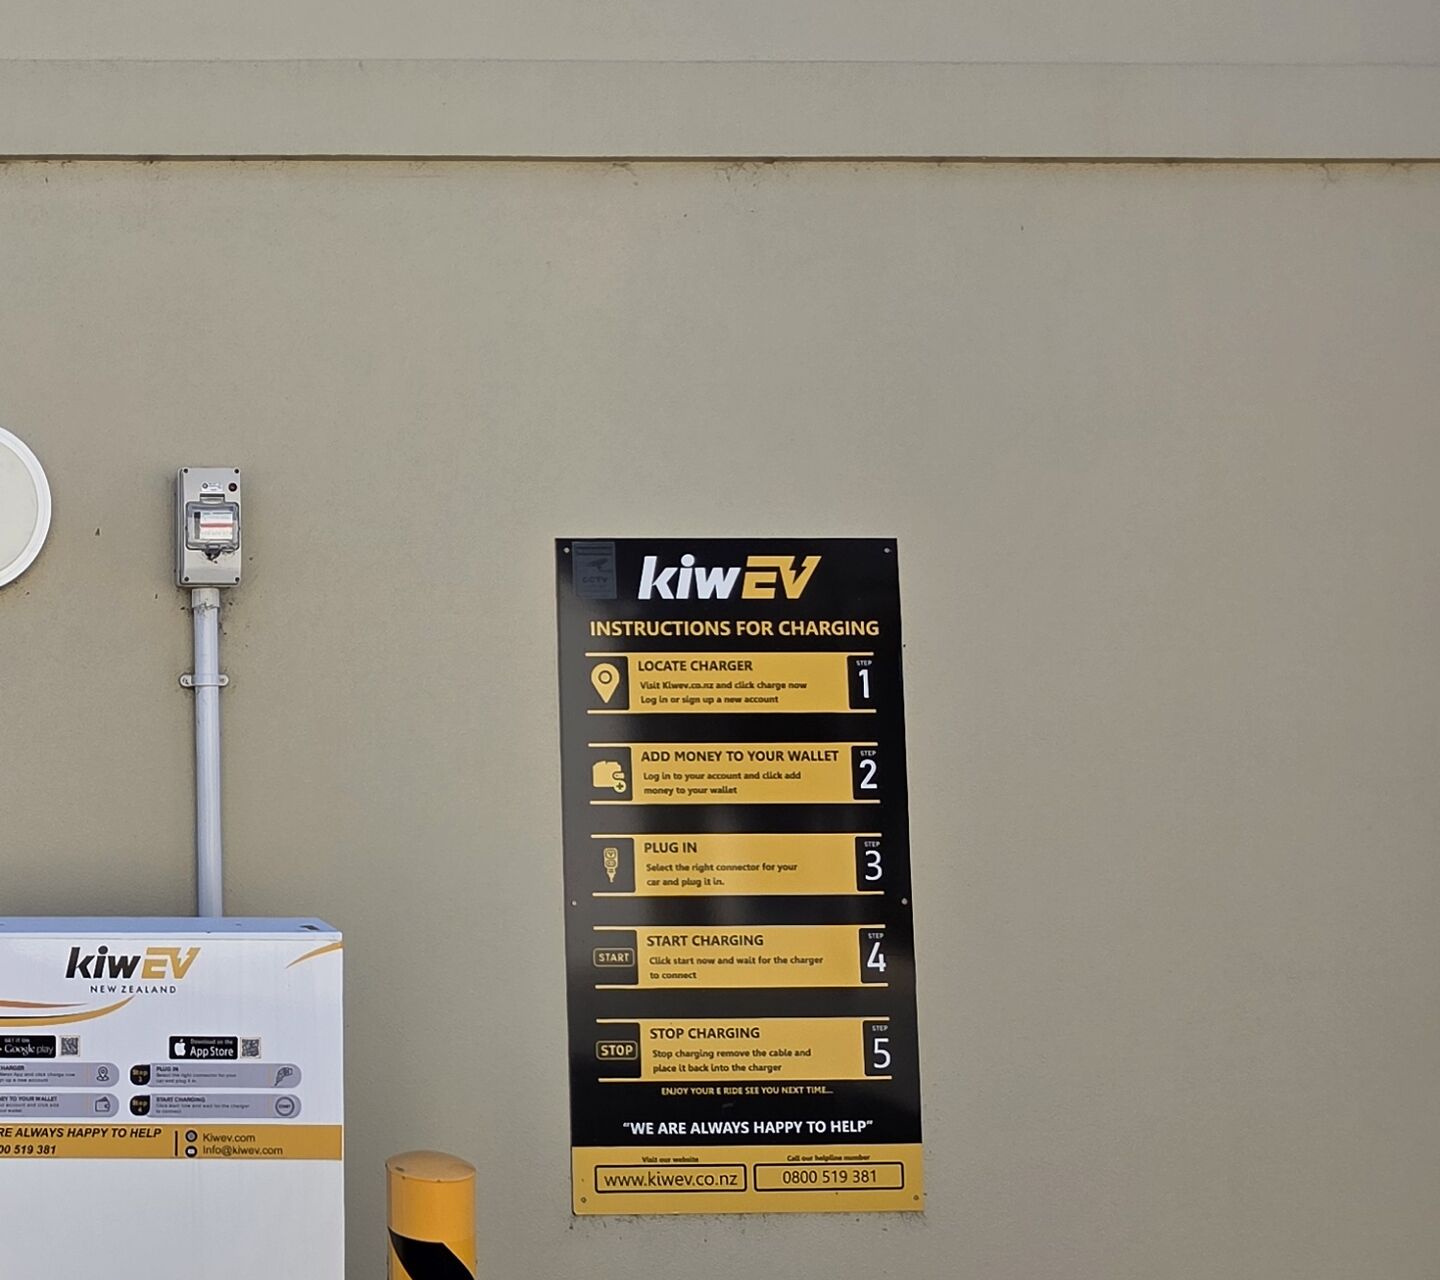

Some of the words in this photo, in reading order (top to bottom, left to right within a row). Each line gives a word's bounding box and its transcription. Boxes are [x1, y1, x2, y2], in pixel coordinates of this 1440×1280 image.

[638, 554, 822, 599] kiwEV
[590, 620, 731, 637] INSTRUCTIONS
[736, 620, 774, 636] FOR
[778, 620, 880, 636] CHARGING
[638, 660, 686, 671] LOCATE
[690, 660, 753, 671] CHARGER
[640, 681, 660, 689] Visit
[662, 681, 714, 689] Kiwev.co.nz
[716, 681, 732, 689] and
[734, 681, 754, 689] click
[756, 681, 786, 691] charge
[858, 669, 870, 699] 1
[640, 696, 657, 705] Log
[682, 695, 700, 705] sign
[702, 697, 714, 705] up
[641, 751, 670, 762] ADD
[674, 751, 722, 762] MONEY
[726, 751, 744, 762] TO
[747, 751, 784, 761] YOUR
[787, 750, 839, 761] WALLET
[643, 772, 659, 782] Log
[661, 772, 670, 780] in
[859, 758, 878, 789] 2
[643, 787, 673, 796] money
[687, 787, 708, 796] your
[709, 786, 737, 794] wallet
[644, 842, 678, 853] PLUG
[682, 842, 697, 853] IN
[692, 863, 714, 873] right
[777, 864, 797, 872] your
[865, 850, 883, 881] 3
[681, 878, 702, 887] plug
[646, 935, 688, 946] START
[692, 935, 764, 946] CHARGING
[65, 945, 201, 979] kiwEV
[598, 953, 629, 962] START
[649, 957, 671, 965] Click
[673, 957, 694, 965] start
[736, 956, 756, 964] wait
[758, 956, 771, 964] for
[773, 956, 788, 964] the
[790, 956, 823, 966] charger
[867, 941, 887, 972] 4
[90, 985, 117, 993] NEW
[121, 985, 177, 993] ZEALAND
[649, 1028, 684, 1039] STOP
[688, 1028, 760, 1039] CHARGING
[4, 1043, 35, 1056] Google
[36, 1044, 54, 1055] play
[190, 1046, 209, 1058] App
[210, 1046, 234, 1057] Store
[600, 1045, 633, 1056] STOP
[652, 1050, 673, 1059] Stop
[675, 1050, 714, 1059] charging
[873, 1038, 891, 1069] 5
[652, 1064, 677, 1073] place
[678, 1064, 686, 1072] it
[688, 1064, 708, 1072] back
[710, 1064, 729, 1072] into
[748, 1063, 782, 1073] charger
[661, 1087, 688, 1095] ENJOY
[690, 1087, 714, 1095] YOUR
[723, 1087, 743, 1095] RIDE
[781, 1086, 804, 1094] NEXT
[14, 1127, 64, 1137] ALWAYS
[67, 1128, 109, 1138] HAPPY
[111, 1128, 127, 1138] TO
[130, 1128, 162, 1138] HELP
[657, 1122, 687, 1134] ARE
[690, 1121, 749, 1134] ALWAYS
[753, 1121, 802, 1133] HAPPY
[806, 1121, 826, 1133] TO
[203, 1133, 256, 1143] Kiwev.com
[14, 1144, 34, 1154] 519
[37, 1144, 56, 1154] 381
[203, 1145, 283, 1156] Info@kiwev.com
[815, 1154, 842, 1162] helpline
[604, 1171, 738, 1186] www.kiwev.co.nz
[782, 1170, 818, 1184] 0800
[822, 1170, 848, 1183] 519
[852, 1170, 877, 1183] 381
